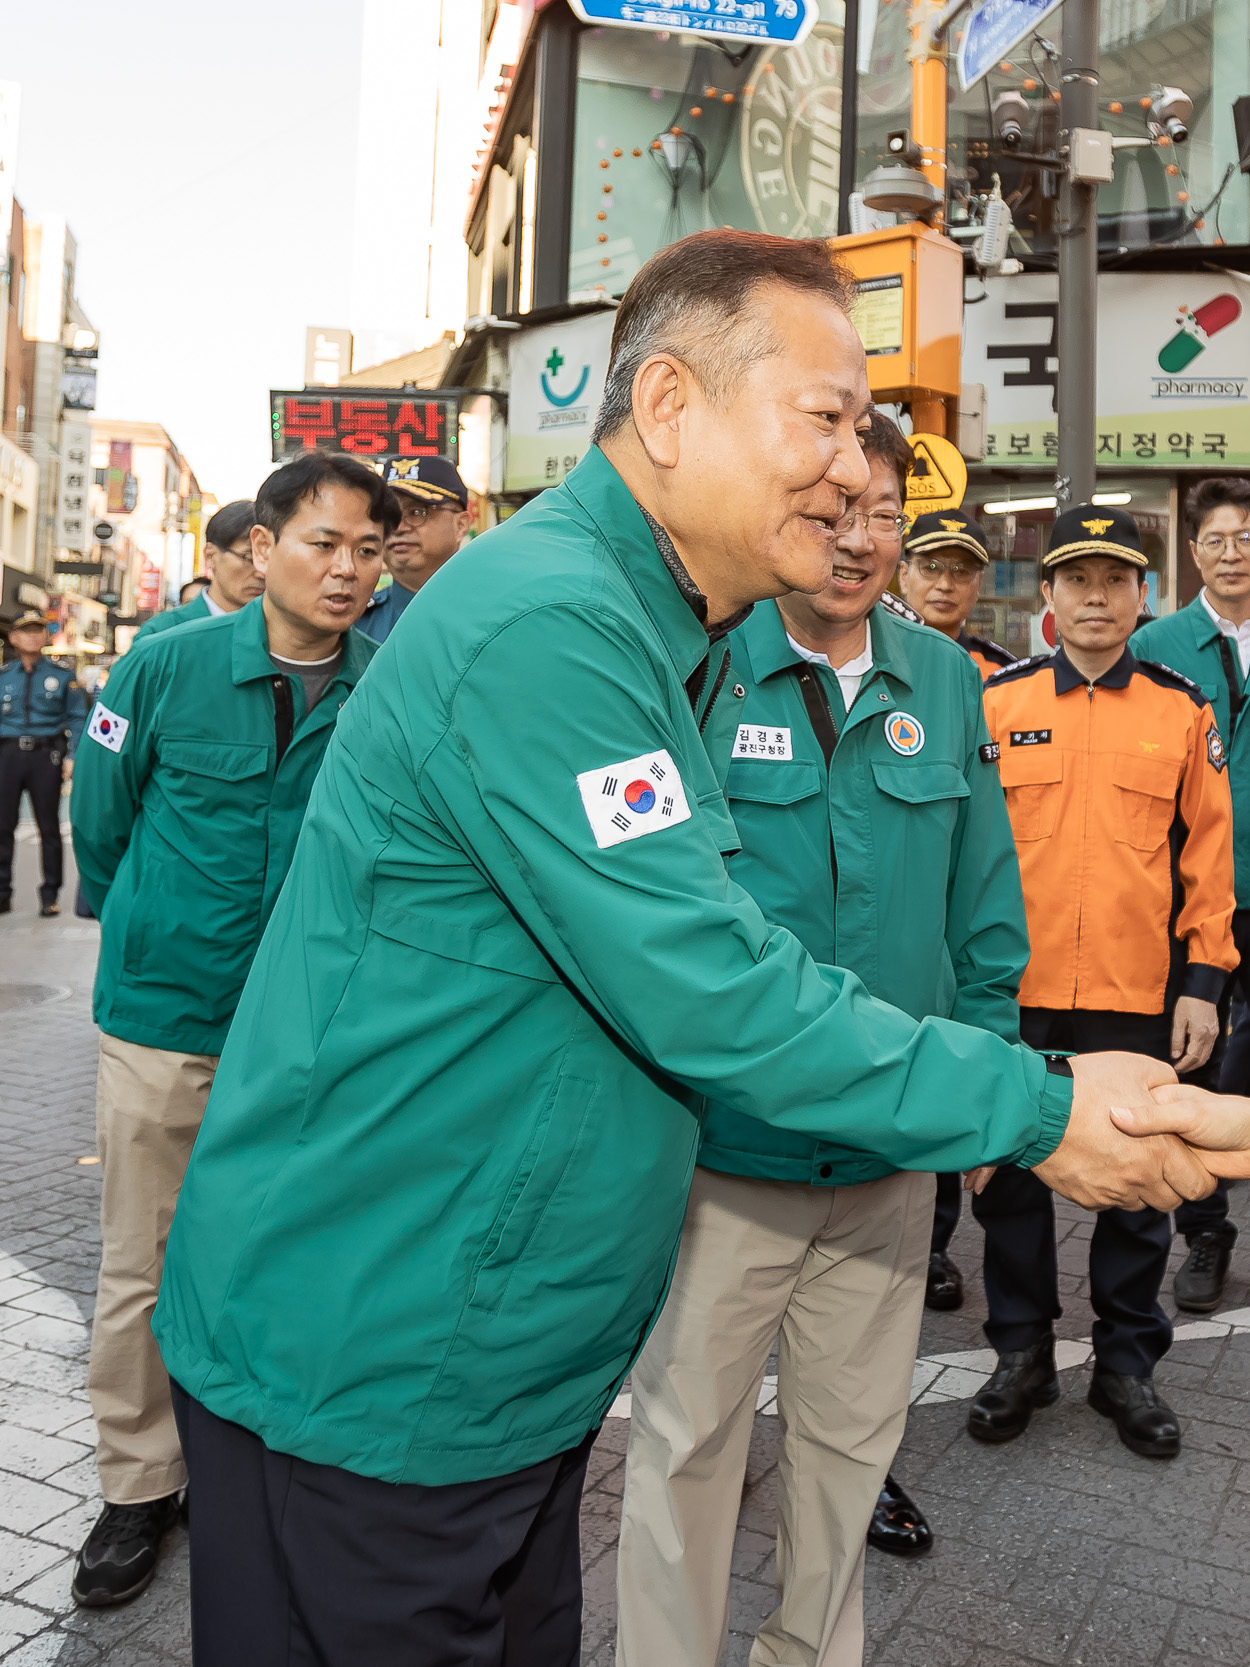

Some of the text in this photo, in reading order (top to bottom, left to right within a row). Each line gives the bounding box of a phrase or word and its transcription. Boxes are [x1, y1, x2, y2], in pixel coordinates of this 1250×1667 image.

[775, 0, 798, 20] 79
[1157, 378, 1244, 398] pharmacy
[283, 397, 445, 457] 부동산
[1097, 432, 1229, 460] 지정약국
[908, 482, 936, 494] SOS
[739, 730, 785, 743] 김경호
[739, 743, 786, 756] 광진구청장
